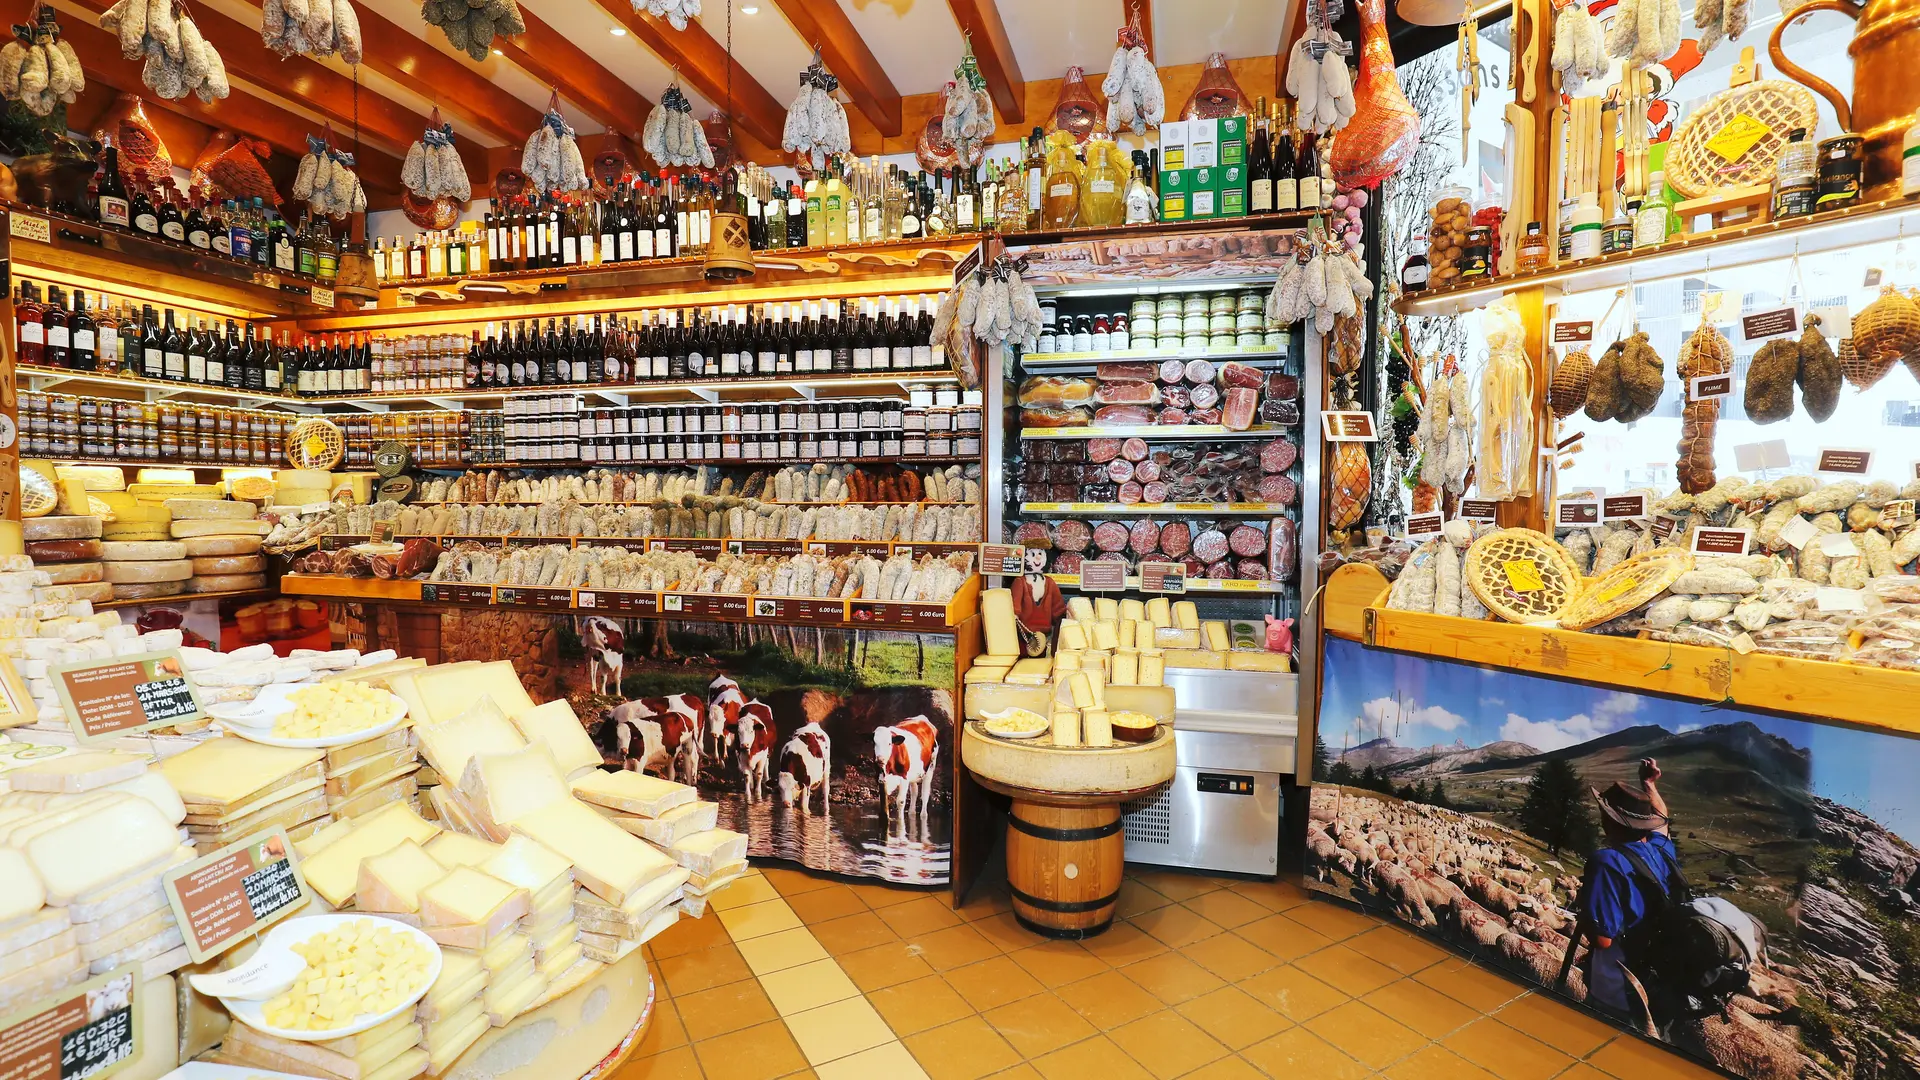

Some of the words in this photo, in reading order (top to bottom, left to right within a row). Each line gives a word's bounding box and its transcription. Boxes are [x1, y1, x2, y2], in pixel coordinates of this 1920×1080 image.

[19, 220, 39, 228] Miel
[1704, 383, 1722, 392] FUMÉ
[818, 606, 831, 614] 6.00
[830, 606, 843, 614] Euro
[919, 610, 932, 618] 6.00
[71, 669, 98, 679] BEAUFORT
[77, 696, 106, 707] Sanitaire
[81, 706, 99, 715] Date:
[98, 703, 114, 712] DDM
[116, 699, 134, 708] DLUO
[84, 714, 101, 723] Code
[88, 723, 101, 732] Prix
[104, 719, 121, 728] Price:
[189, 865, 219, 881] ABONDANCE
[218, 856, 237, 867] FERMIER
[190, 901, 216, 917] Sanitaire
[197, 925, 213, 936] Code
[227, 963, 268, 984] Abondance
[89, 1024, 127, 1050] MARS
[86, 1038, 121, 1061] 2020
